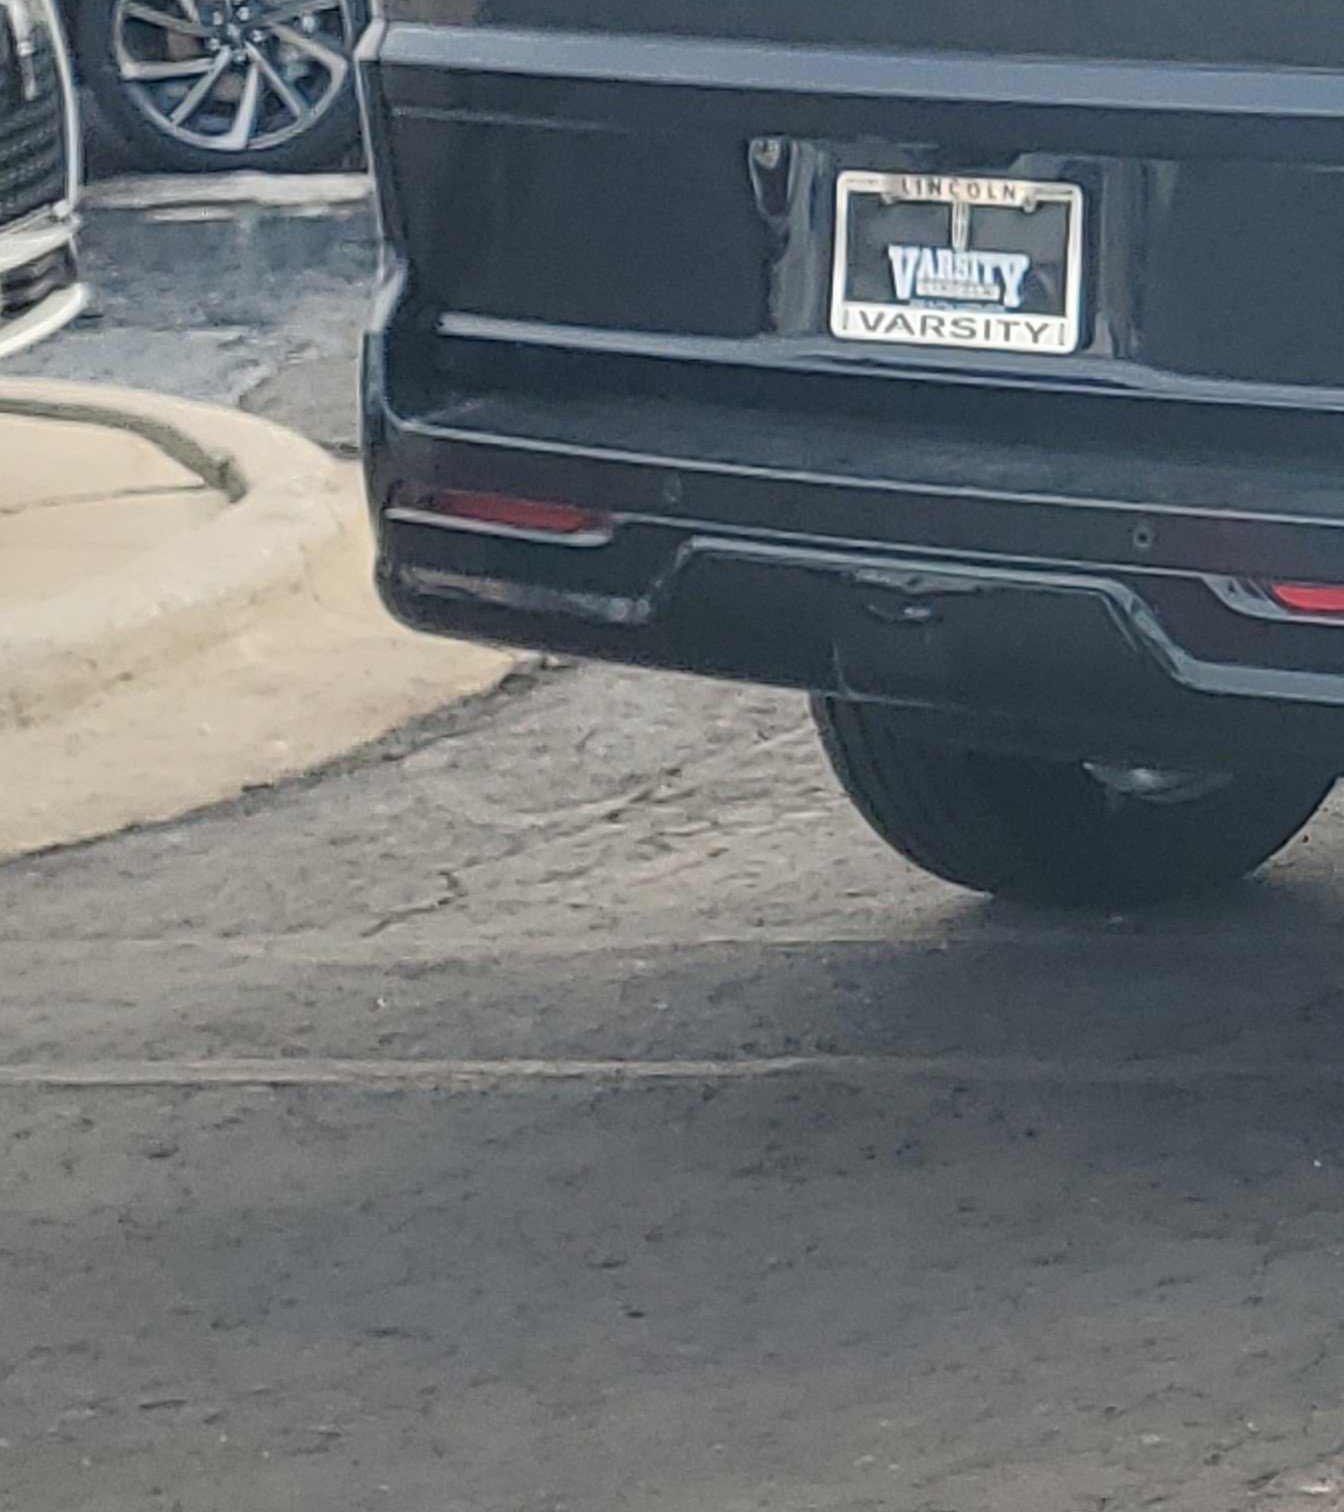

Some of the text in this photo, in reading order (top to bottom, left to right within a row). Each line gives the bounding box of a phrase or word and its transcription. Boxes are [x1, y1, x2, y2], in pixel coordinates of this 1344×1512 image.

[900, 177, 1017, 200] LINCOLN
[887, 243, 1030, 308] VARSITY
[858, 310, 1049, 344] VARSITY
